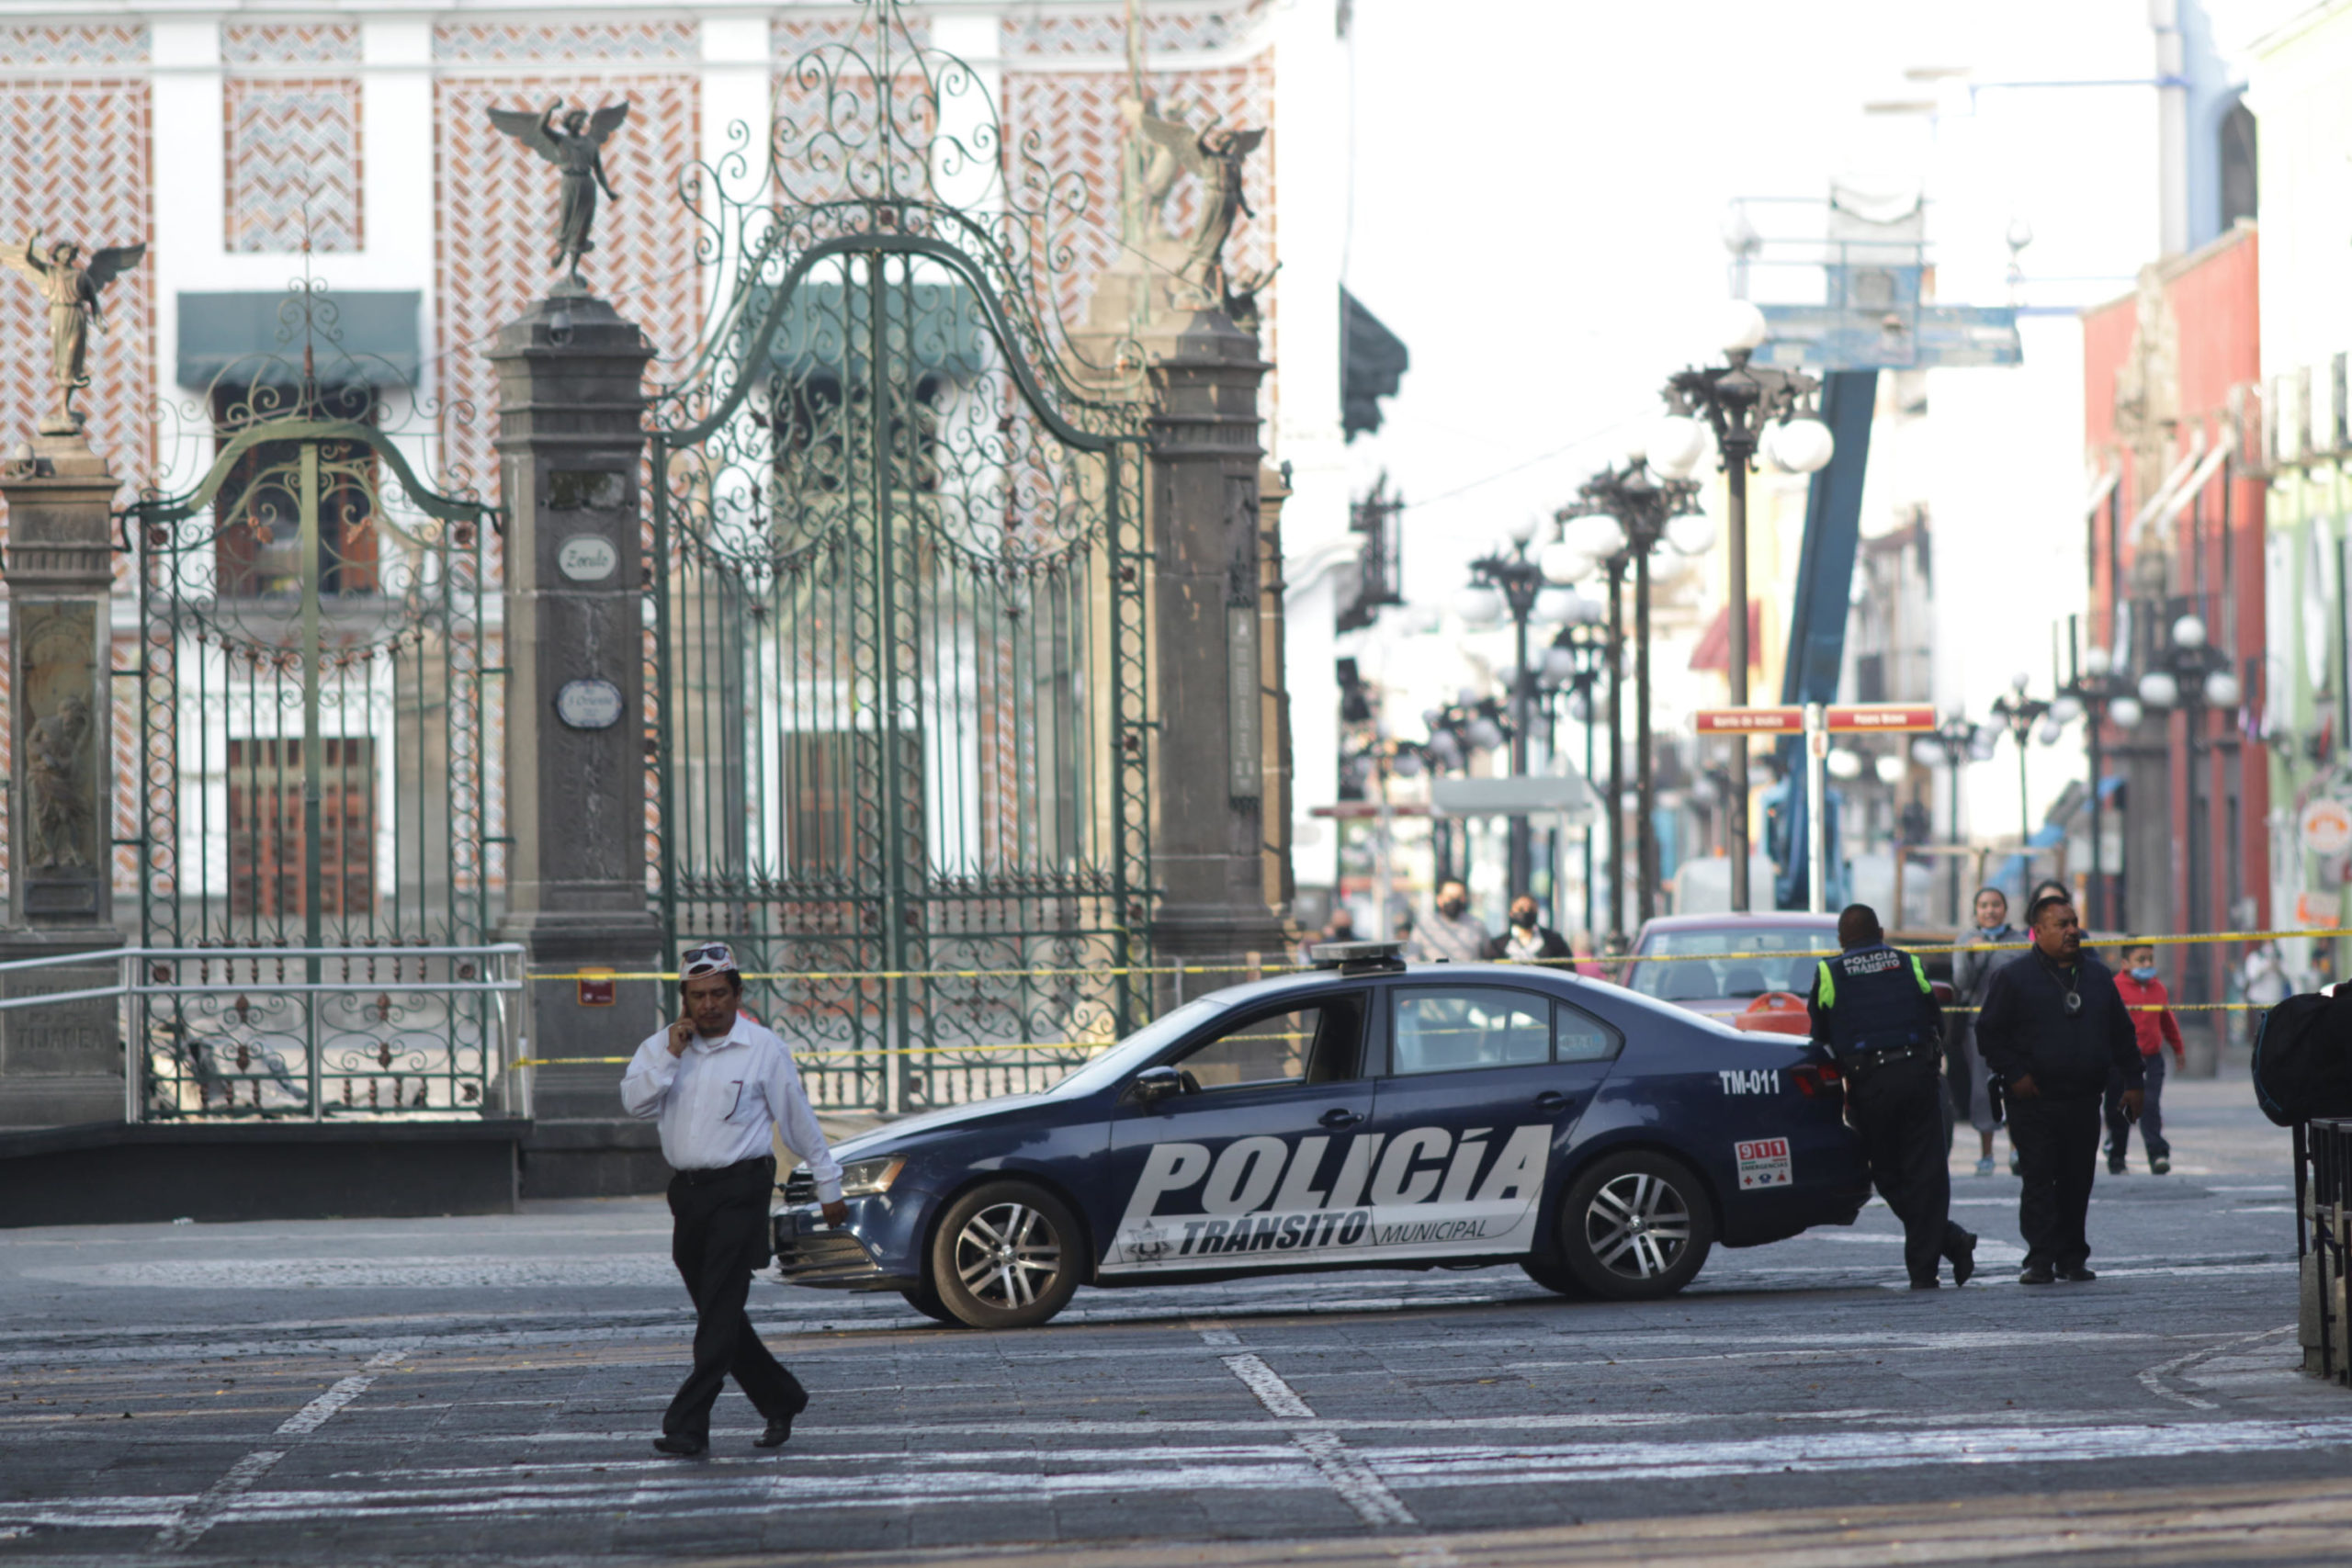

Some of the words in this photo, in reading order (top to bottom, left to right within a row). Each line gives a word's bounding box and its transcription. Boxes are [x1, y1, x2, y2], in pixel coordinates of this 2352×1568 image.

[1719, 1069, 1781, 1095] TM-011
[1739, 1141, 1786, 1160] 911
[1120, 1123, 1554, 1217] POLICÍA
[1741, 1162, 1788, 1171] EMERGENCIAS
[1179, 1210, 1369, 1255] TRÁNSITO
[1380, 1220, 1487, 1244] MUNICIPAL
